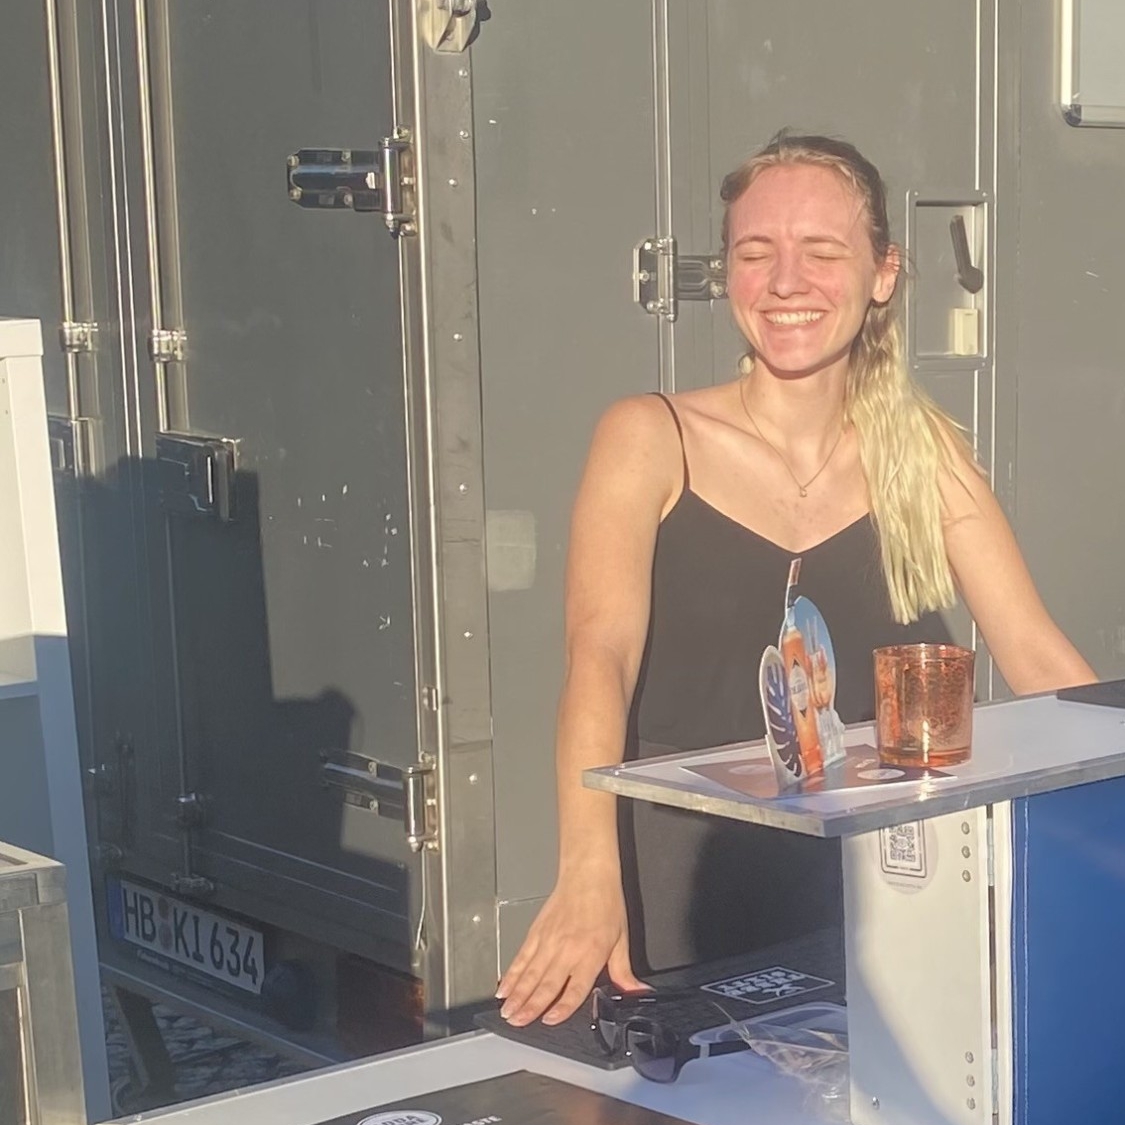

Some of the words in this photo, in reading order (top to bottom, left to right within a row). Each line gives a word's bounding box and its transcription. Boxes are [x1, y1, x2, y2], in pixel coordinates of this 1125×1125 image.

[123, 888, 156, 943] HB
[173, 907, 205, 964] KI
[210, 922, 258, 985] 634
